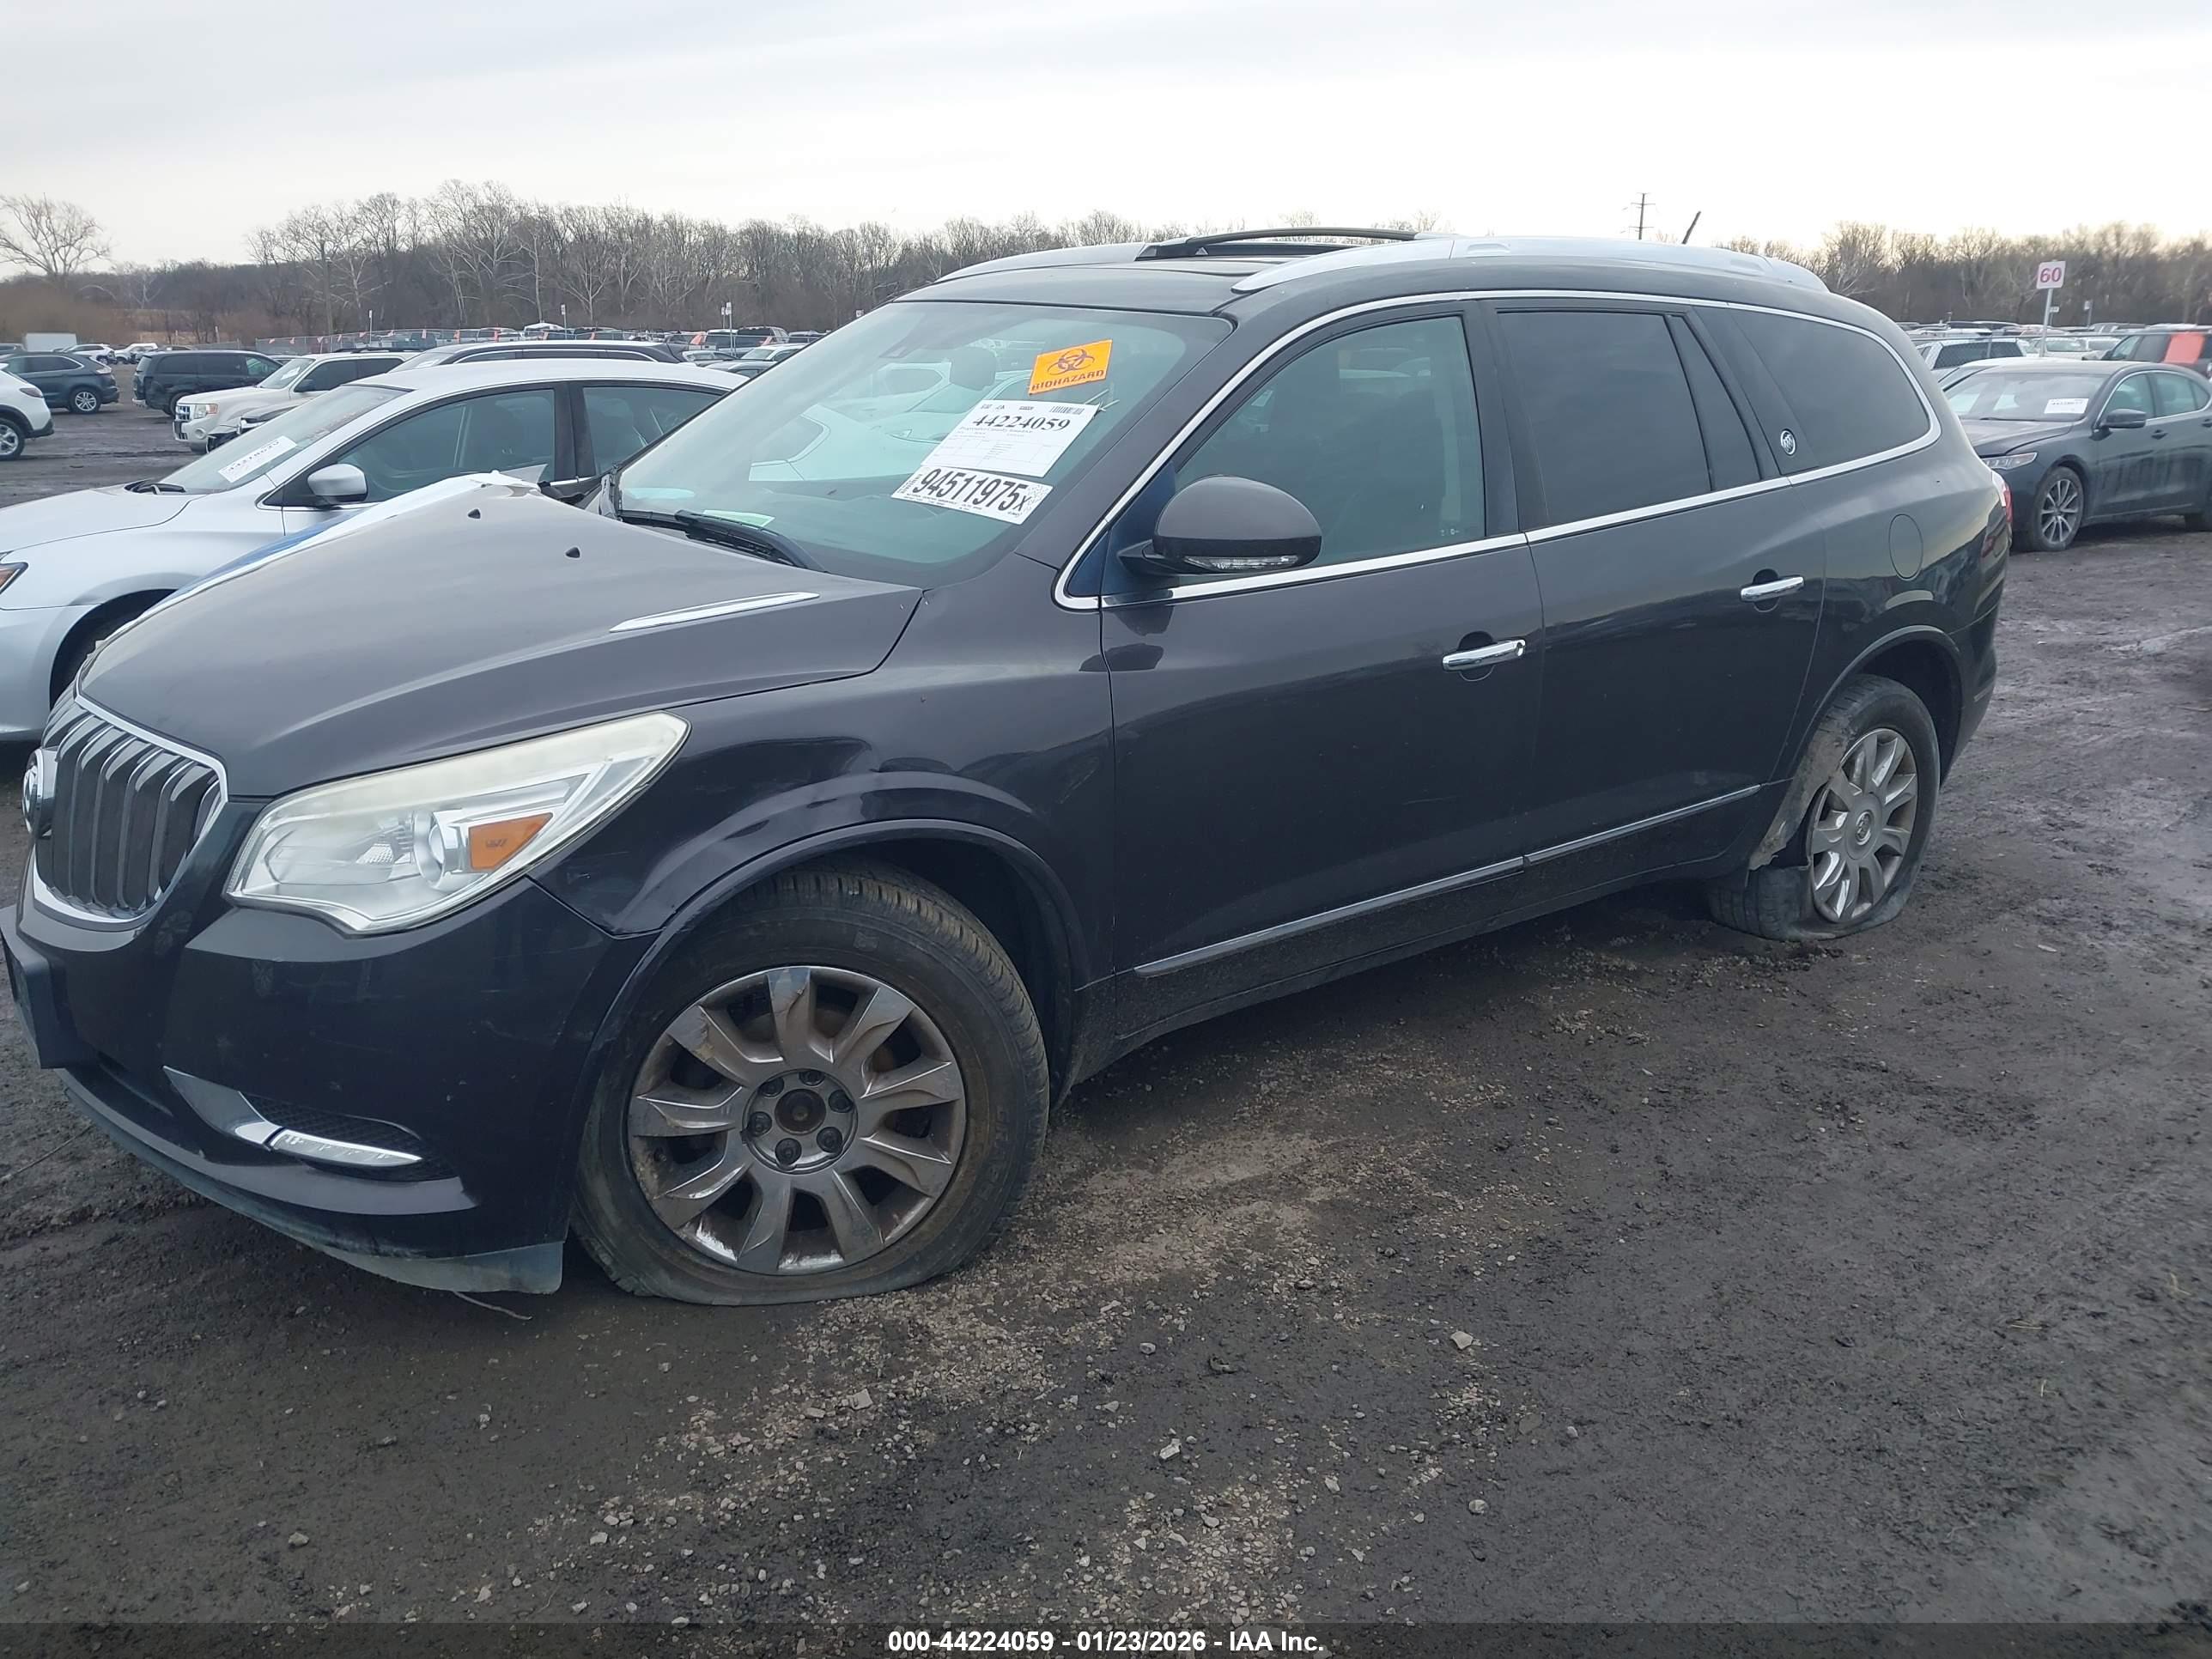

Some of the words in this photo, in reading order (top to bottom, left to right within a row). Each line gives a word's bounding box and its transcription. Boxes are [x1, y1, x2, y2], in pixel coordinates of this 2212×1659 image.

[2040, 267, 2062, 283] 60
[1031, 369, 1104, 391] BIOHAZARD
[973, 414, 1071, 431] 44224059
